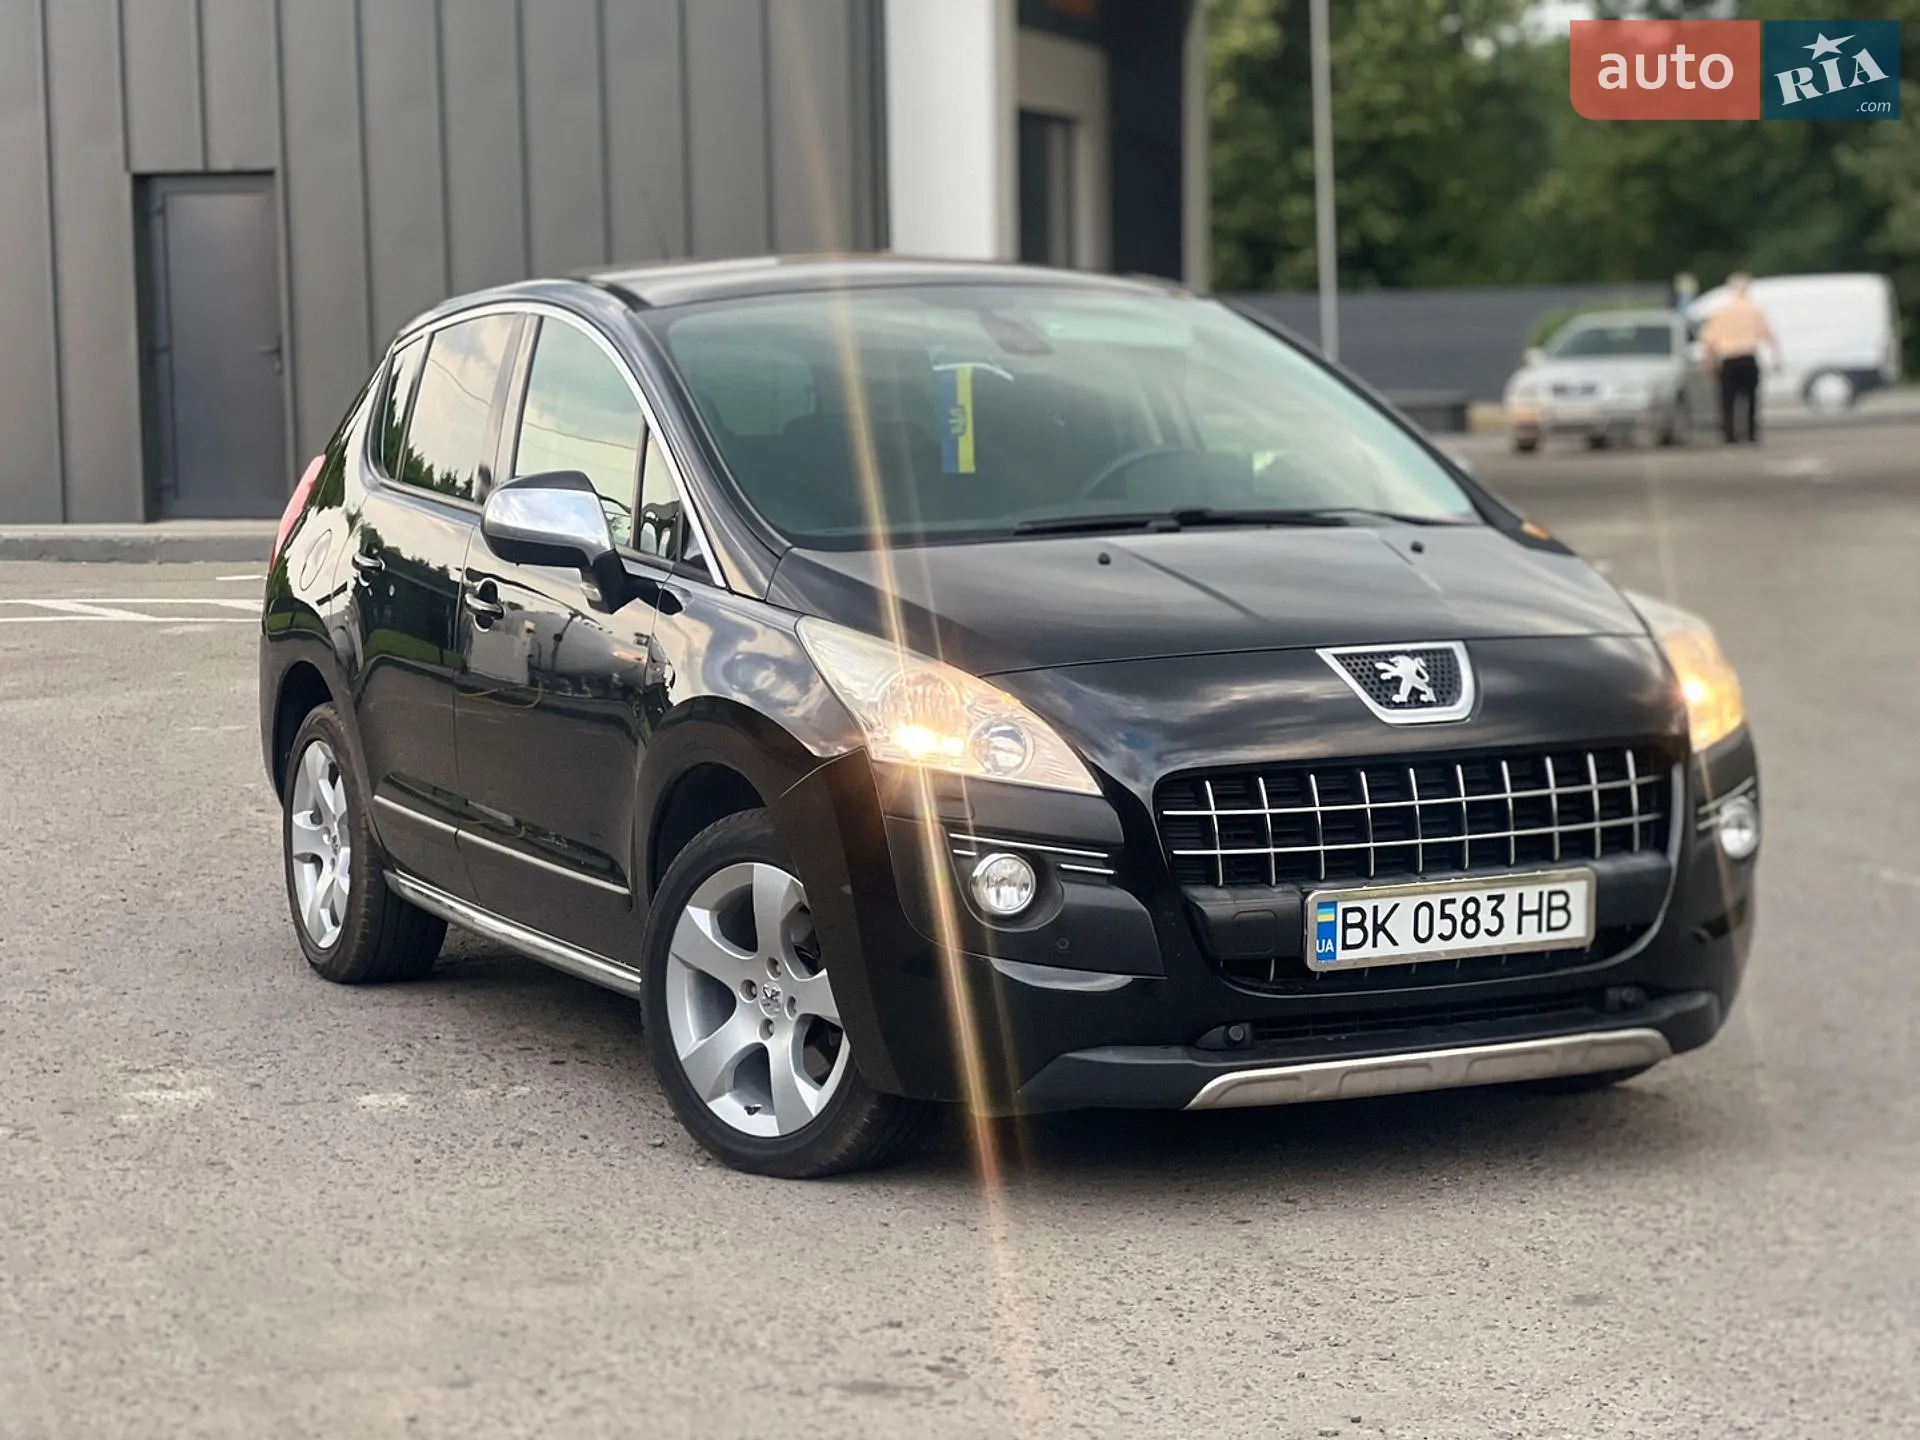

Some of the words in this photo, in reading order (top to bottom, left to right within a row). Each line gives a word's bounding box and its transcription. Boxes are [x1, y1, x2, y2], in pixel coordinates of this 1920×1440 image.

[1341, 902, 1400, 951] BK
[1413, 893, 1506, 945] 0583
[1517, 889, 1572, 935] HB
[1316, 939, 1335, 954] UA
